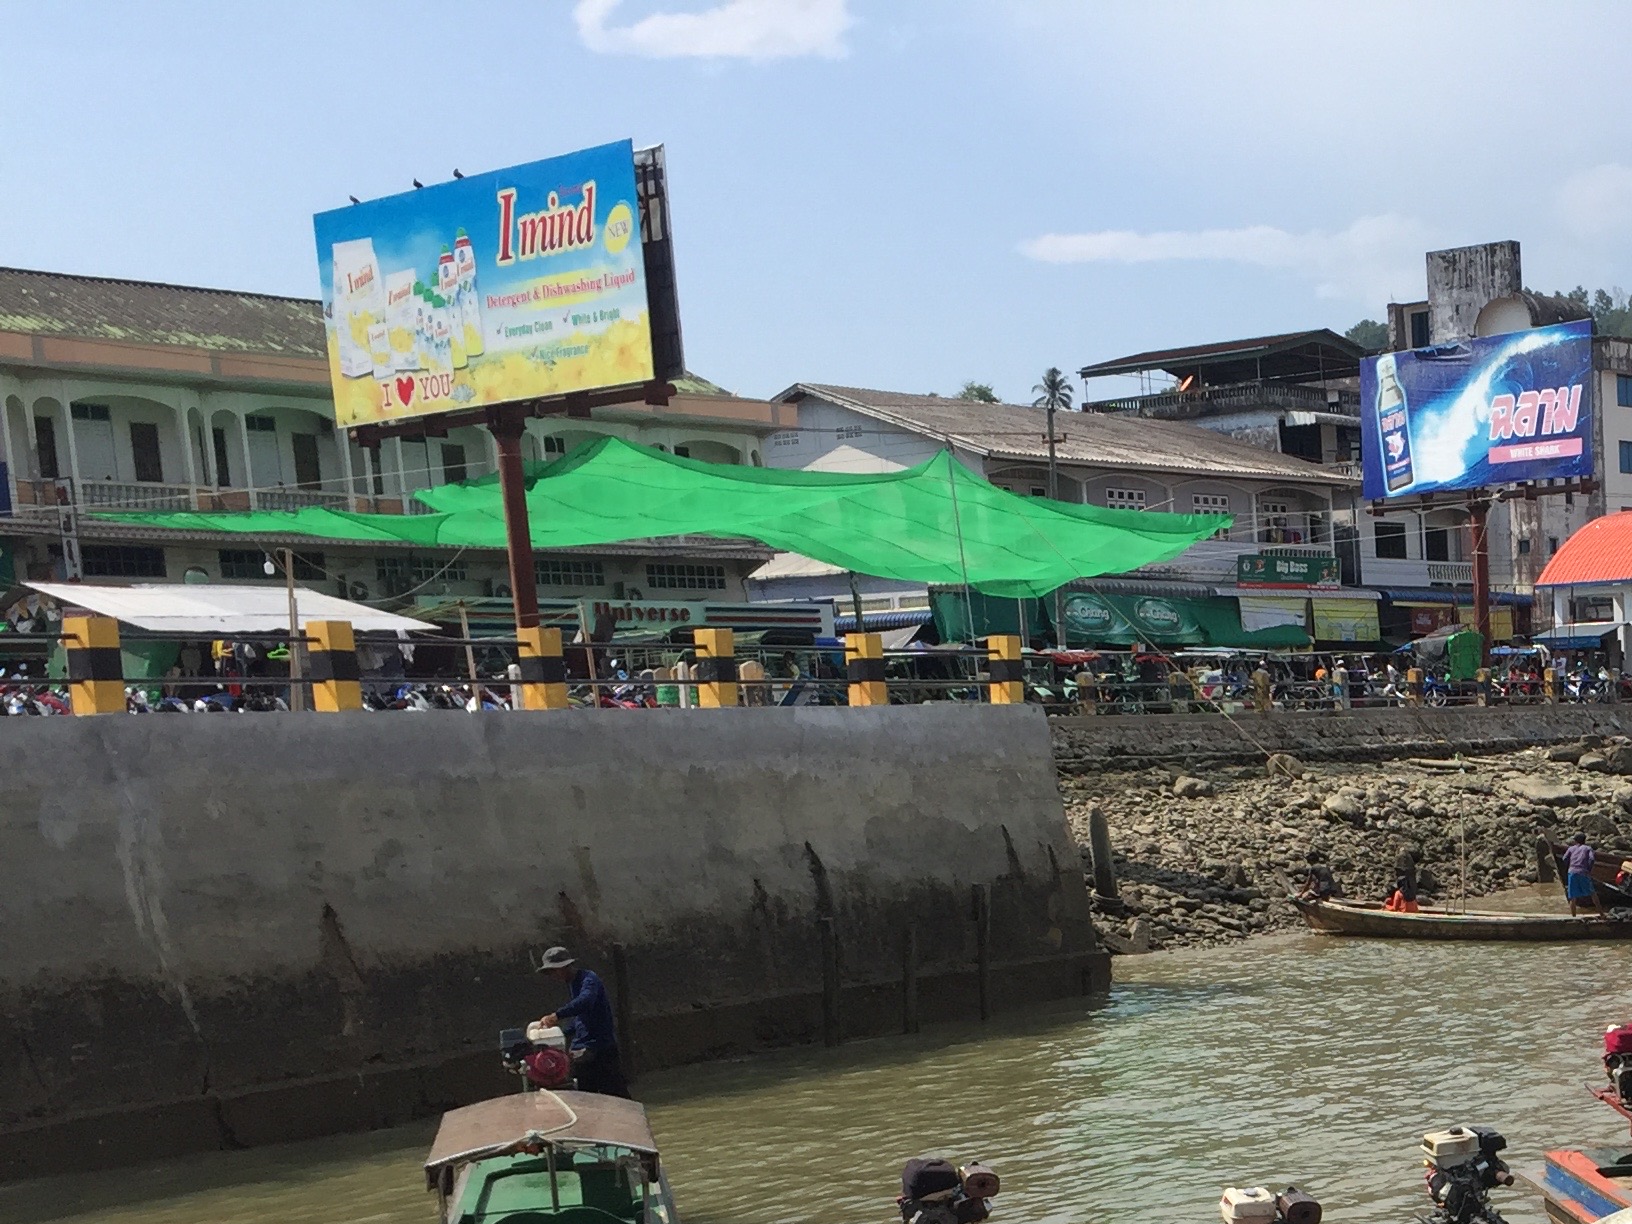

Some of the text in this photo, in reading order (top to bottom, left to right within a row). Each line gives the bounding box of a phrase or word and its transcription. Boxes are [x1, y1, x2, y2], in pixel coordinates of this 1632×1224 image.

[499, 186, 594, 262] I mind
[608, 220, 629, 238] NEW
[487, 267, 636, 309] Detergent & Dishwashing Liquid
[382, 374, 450, 407] I YOU
[1489, 384, 1582, 440] ฉลาม
[1510, 446, 1533, 458] WHITE
[1276, 560, 1289, 574] Big
